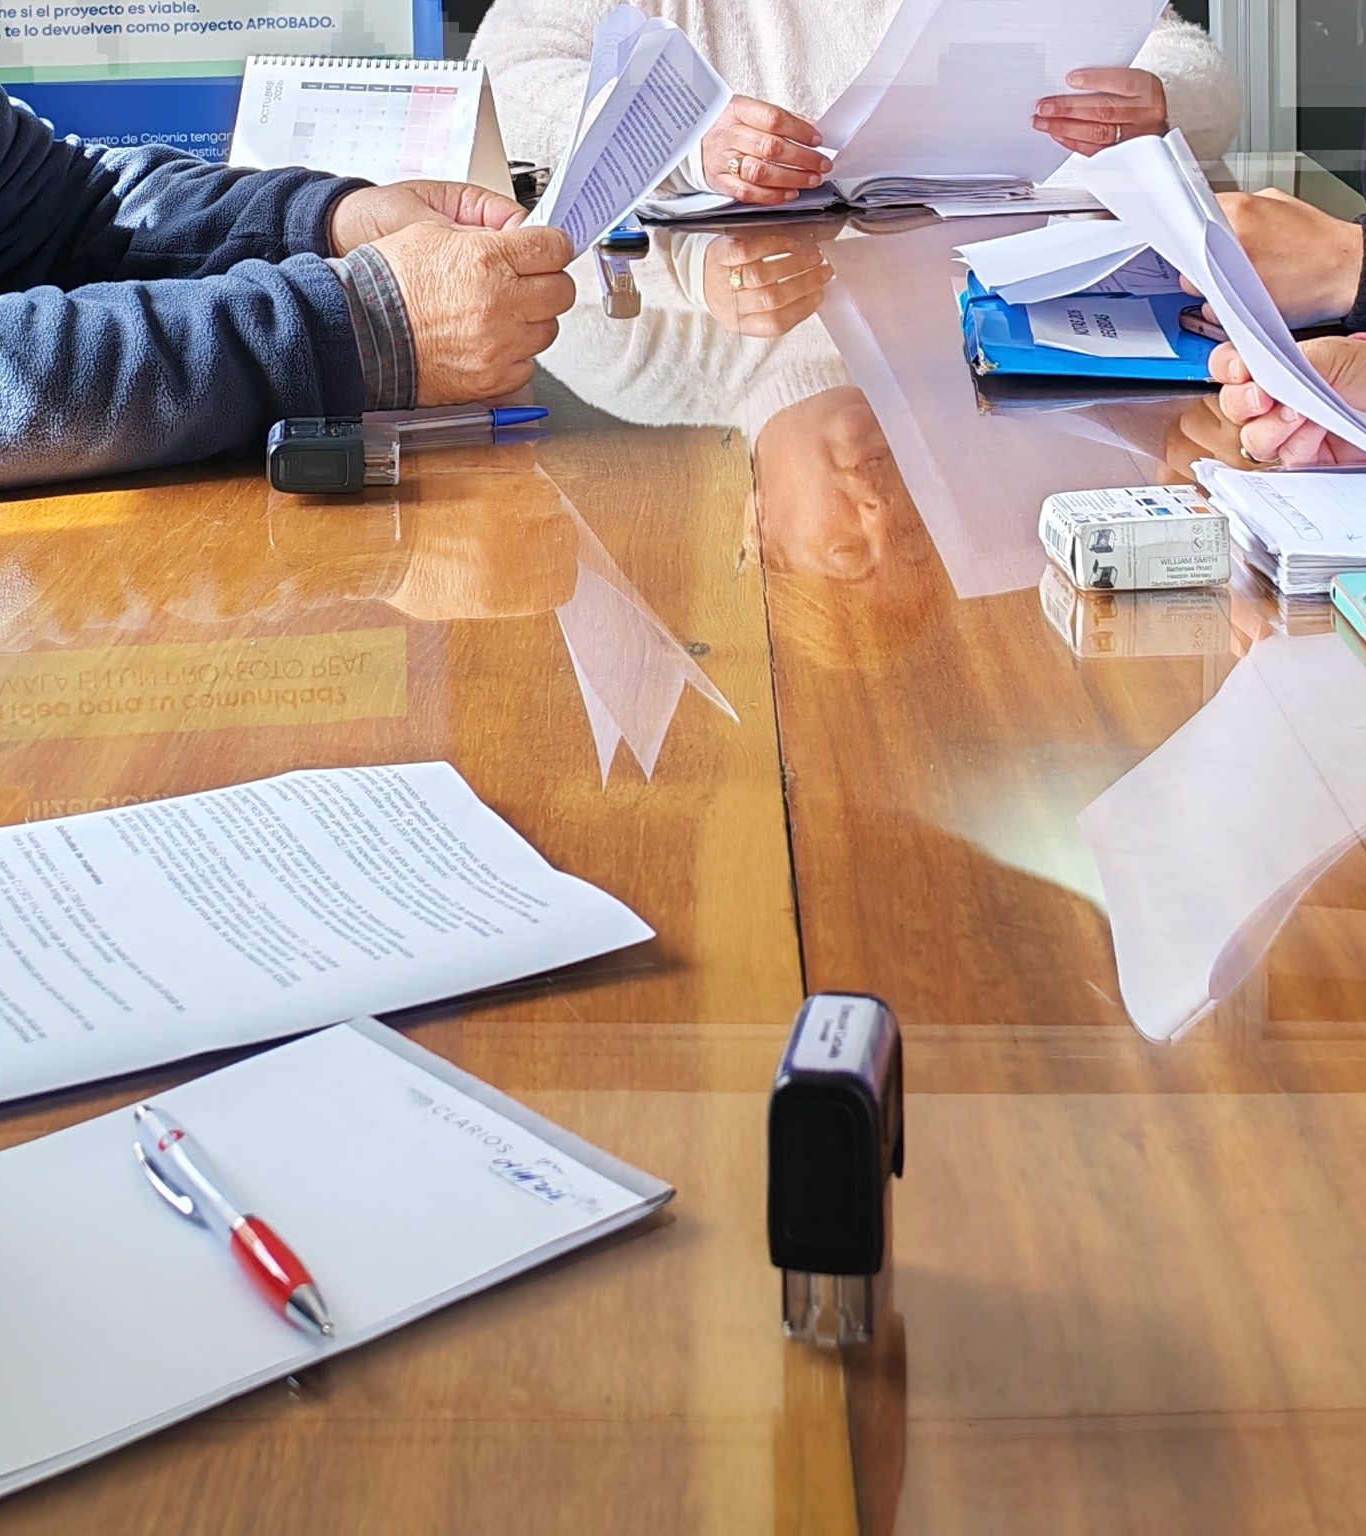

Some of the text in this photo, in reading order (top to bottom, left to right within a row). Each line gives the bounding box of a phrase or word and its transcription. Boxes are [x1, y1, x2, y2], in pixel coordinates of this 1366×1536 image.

[20, 4, 33, 19] si
[35, 4, 50, 18] el
[54, 4, 125, 20] proyecto
[127, 4, 146, 15] es
[148, 0, 201, 14] viable.
[4, 25, 21, 38] te
[24, 24, 39, 37] lo
[42, 21, 123, 37] devuelven
[125, 22, 171, 34] como
[174, 19, 244, 35] proyecto
[245, 16, 336, 30] APROBADO.
[260, 79, 275, 124] OCTUBRE
[77, 136, 118, 146] mento
[121, 133, 138, 144] de
[140, 132, 188, 144] Colonia
[1160, 556, 1218, 565] WILLIAM SMITH
